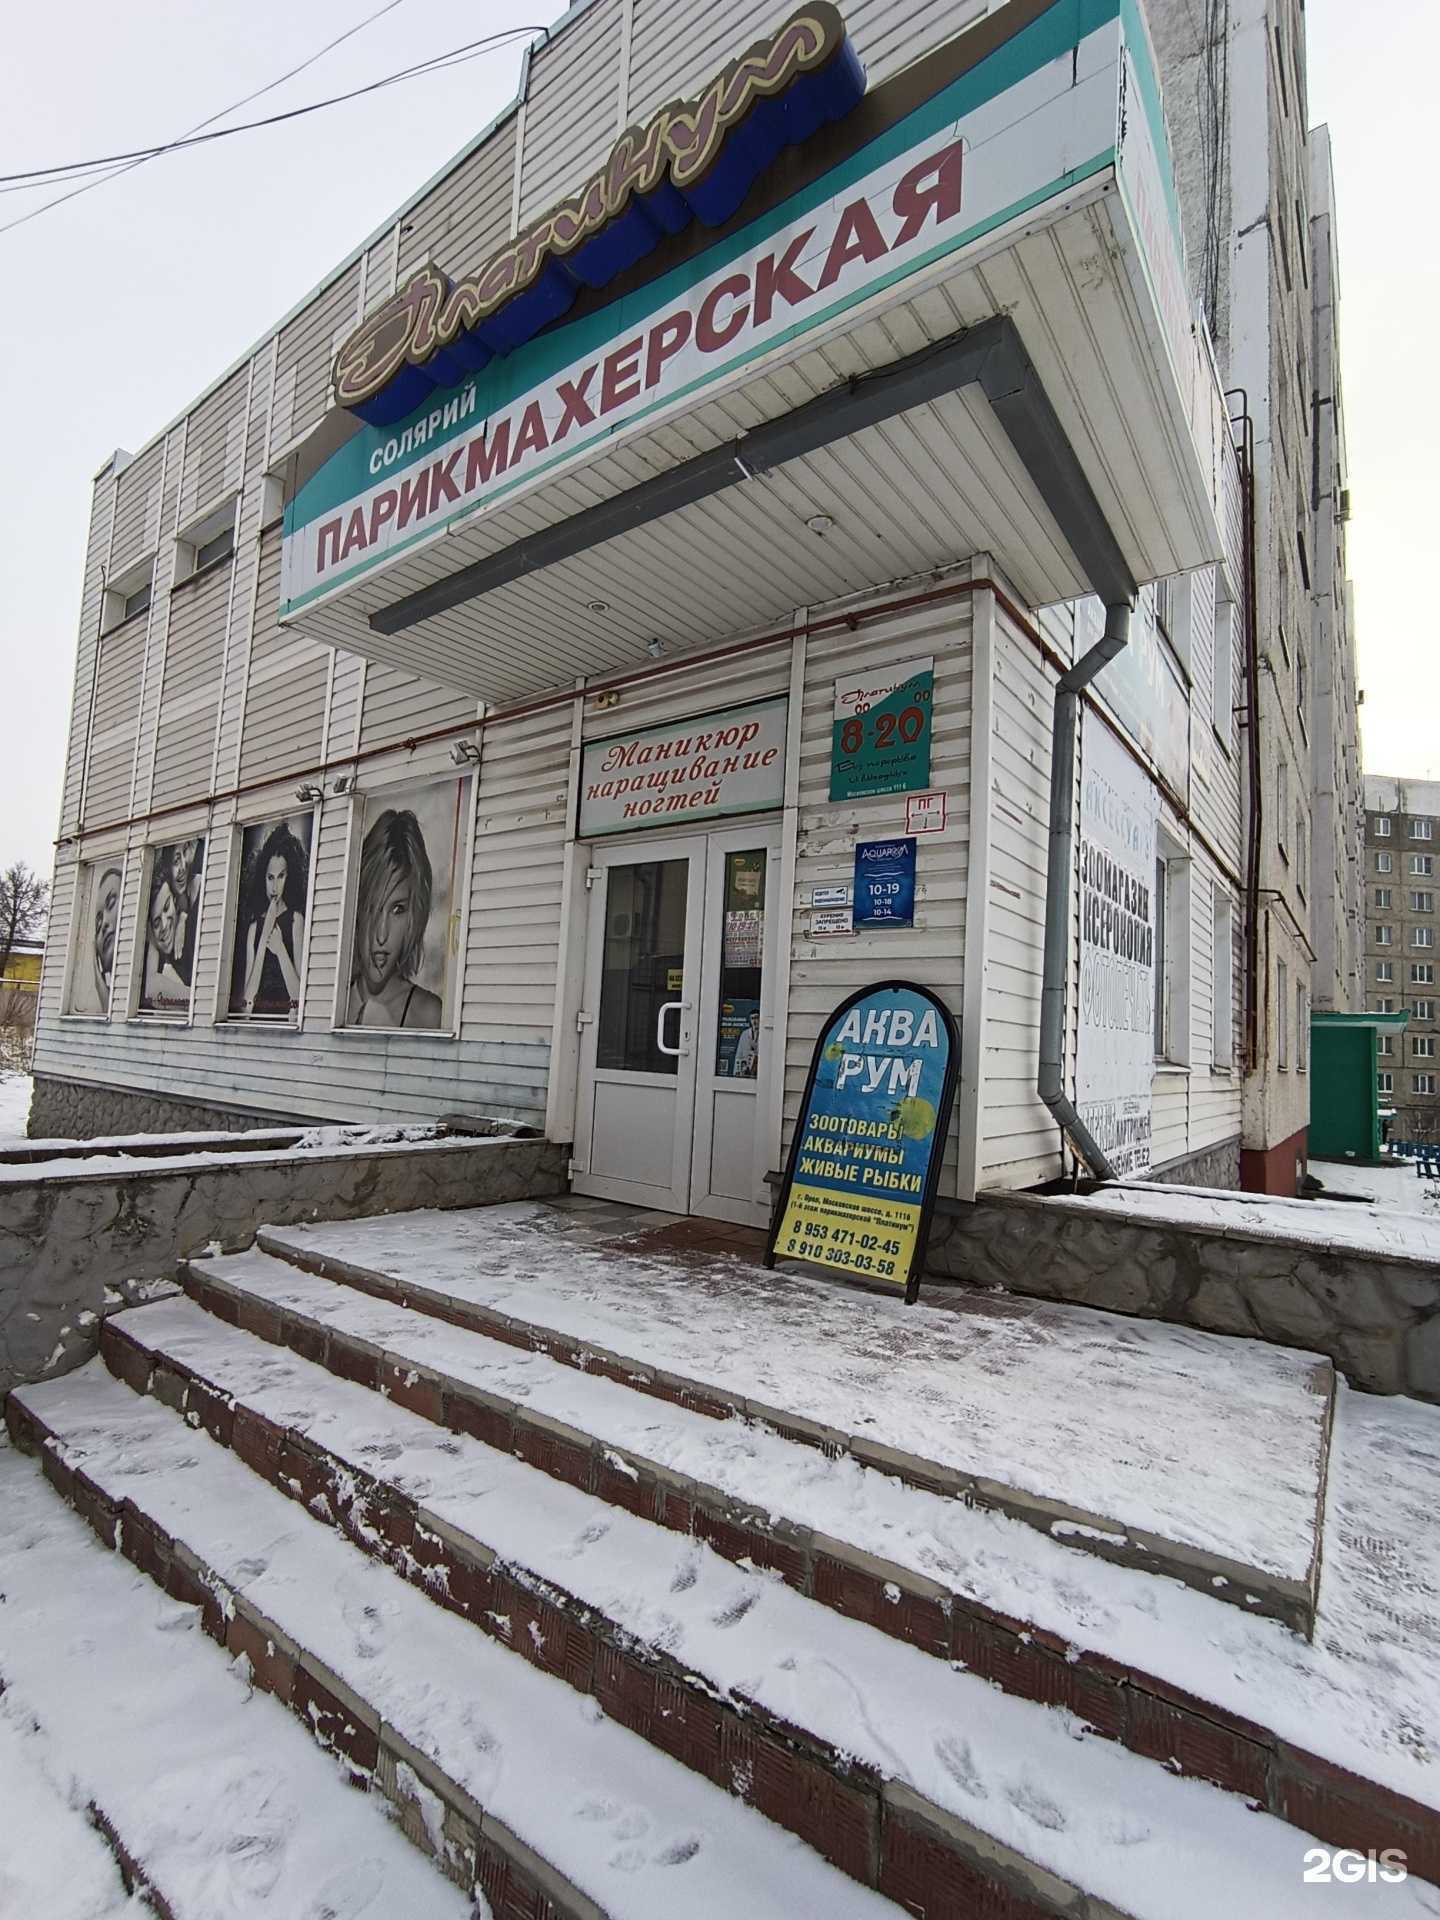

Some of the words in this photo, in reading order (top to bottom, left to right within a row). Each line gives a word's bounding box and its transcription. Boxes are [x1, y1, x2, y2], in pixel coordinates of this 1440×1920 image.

[316, 138, 965, 574] ПАРИКМАХЕРСКАЯ
[369, 382, 477, 475] СОЛЯРИЙ
[601, 720, 760, 774] Маникюр
[586, 748, 778, 802] наращивание
[622, 779, 722, 819] ногтей
[917, 798, 934, 811] ПГ
[869, 883, 900, 896] 10-19
[1081, 839, 1150, 923] ЗООМАГАЗИН
[1082, 888, 1153, 968] КСЕРОКОПИЯ
[837, 1008, 939, 1048] АКВА
[836, 1052, 924, 1098] РУМ
[809, 1113, 904, 1141] ЗООТОВАРЫ
[803, 1135, 905, 1165] АКВАРИУМЫ
[799, 1157, 858, 1183] ЖИВЫЕ
[862, 1168, 922, 1193] РЫБКИ
[787, 1239, 796, 1253] 8
[798, 1240, 822, 1259] 910
[824, 1247, 895, 1276] 303-03-58
[793, 1219, 802, 1235] 8
[804, 1221, 829, 1240] 953
[831, 1226, 900, 1256] 471-02-45
